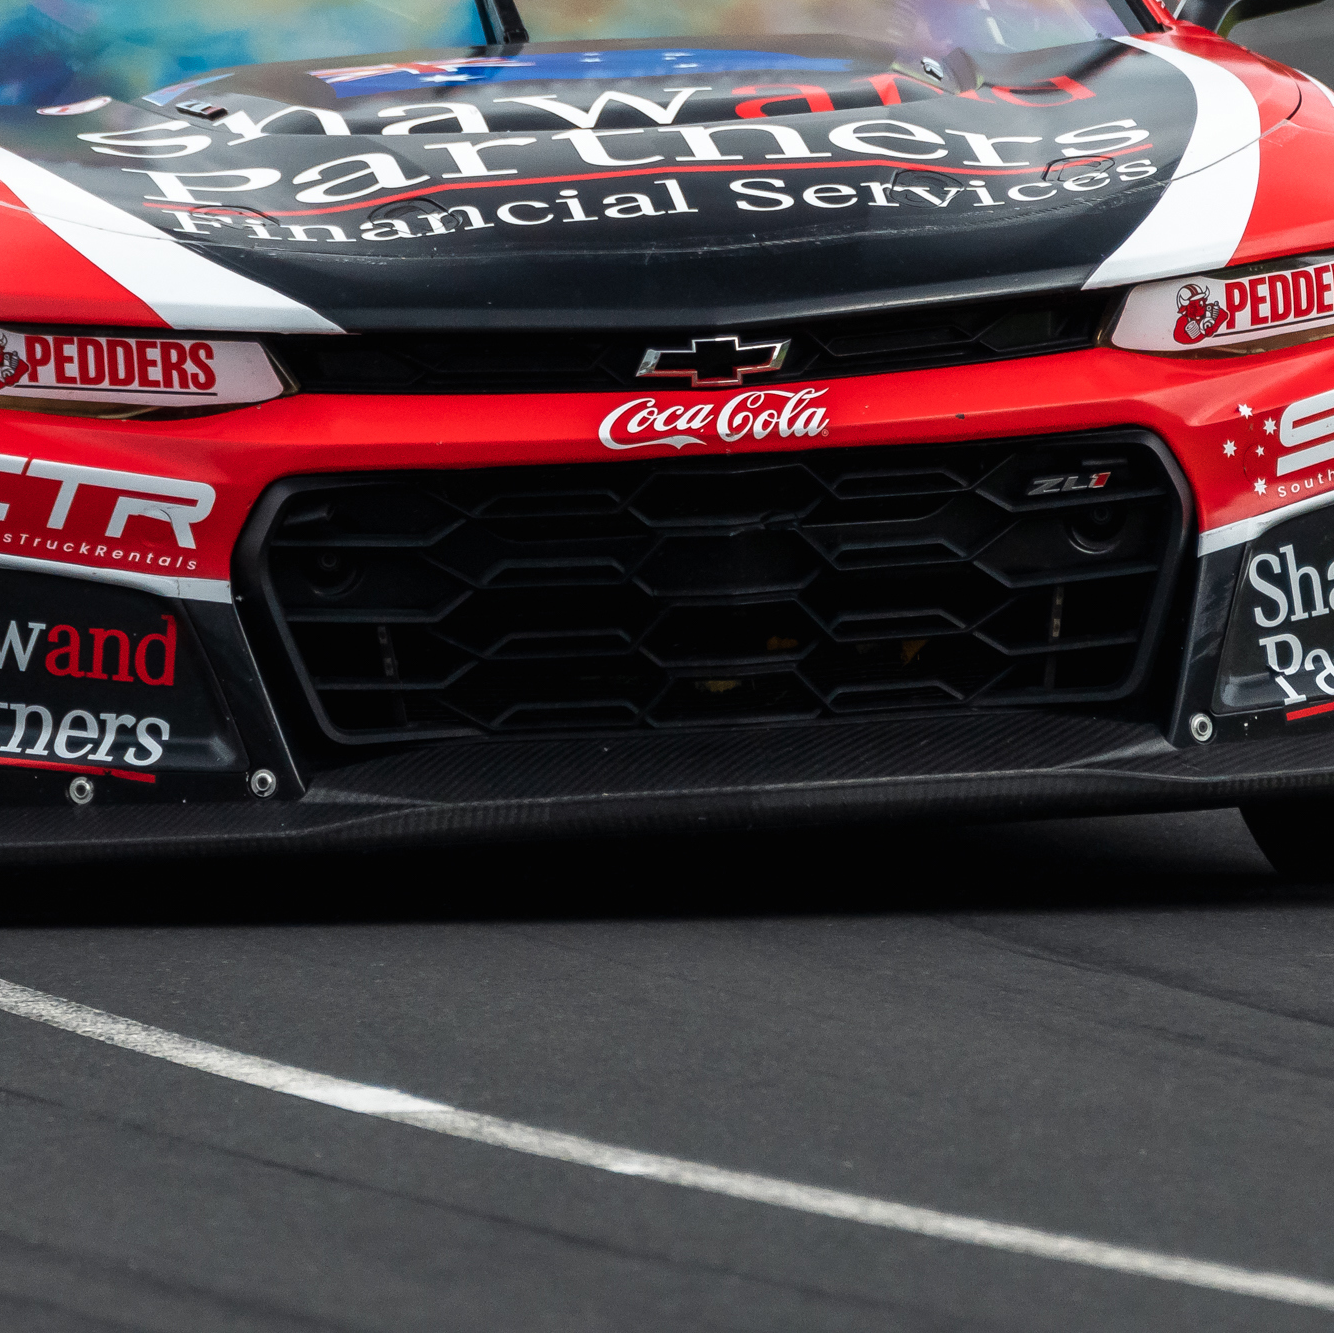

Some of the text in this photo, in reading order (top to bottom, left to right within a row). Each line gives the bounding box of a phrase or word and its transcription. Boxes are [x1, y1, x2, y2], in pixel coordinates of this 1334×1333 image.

[122, 118, 1150, 206] Partners
[162, 155, 1158, 242] Financial Services
[24, 334, 218, 392] PEDDERS
[1027, 471, 1112, 497] ZL1
